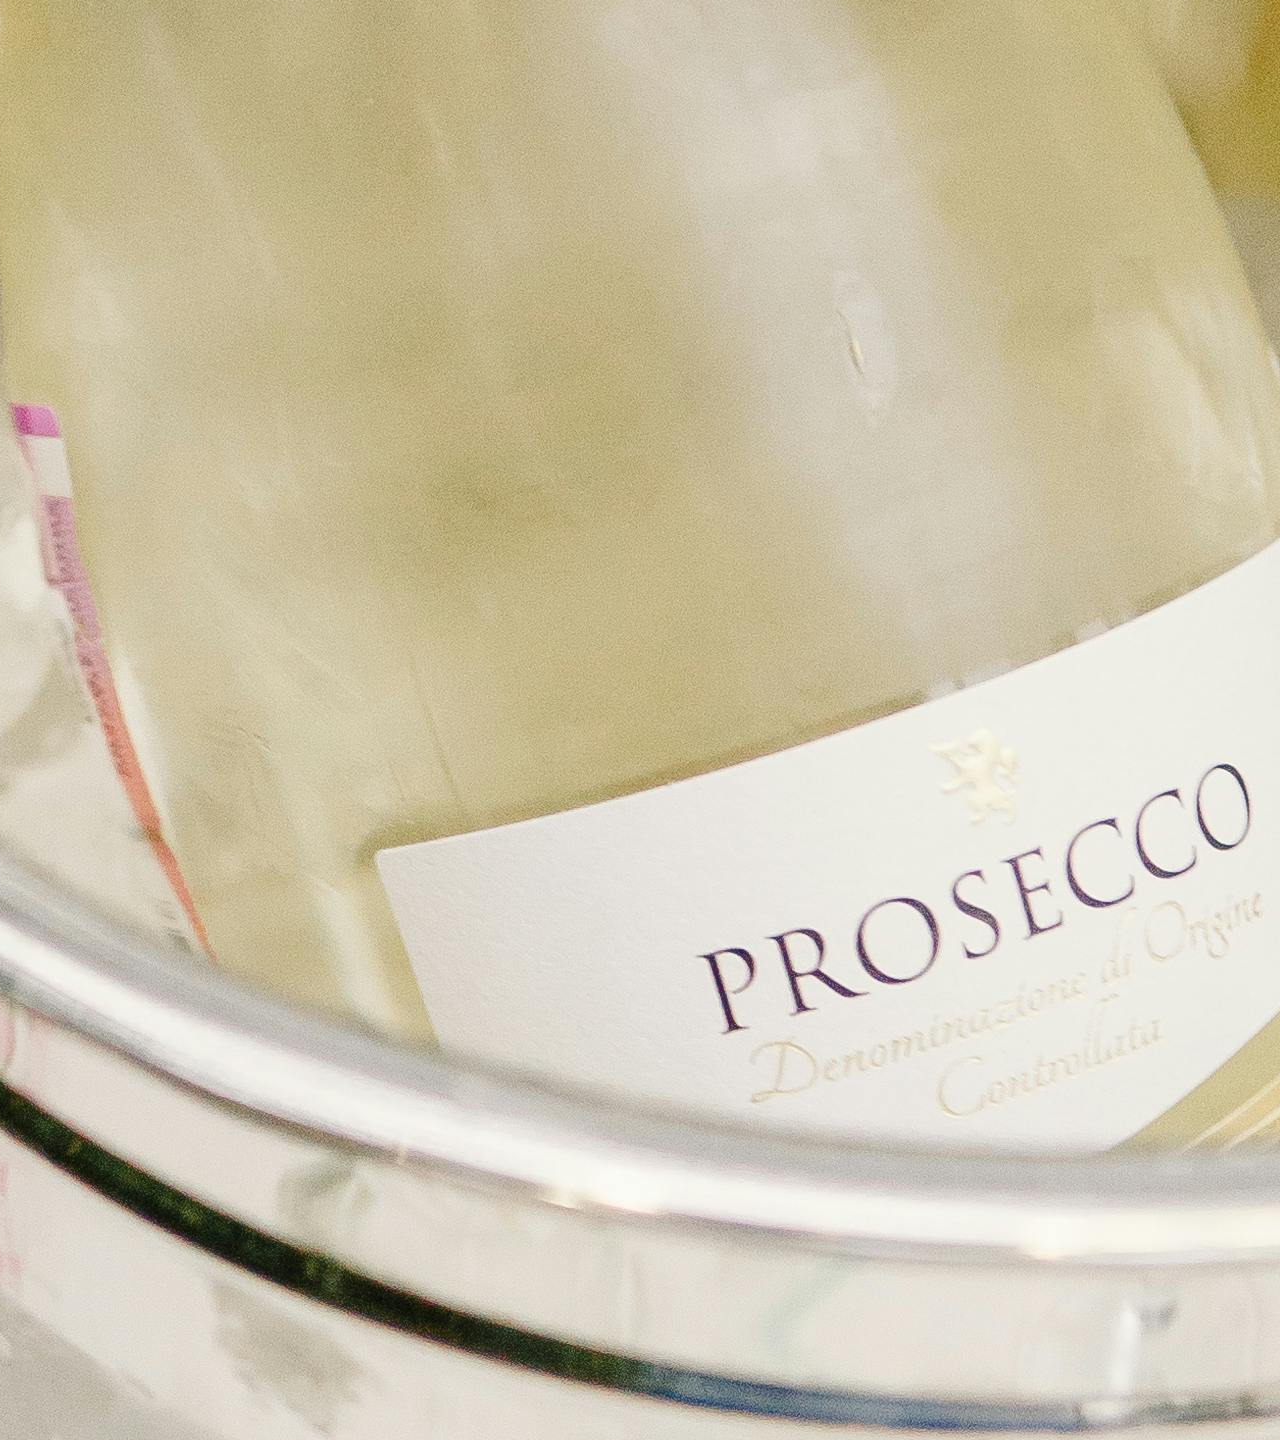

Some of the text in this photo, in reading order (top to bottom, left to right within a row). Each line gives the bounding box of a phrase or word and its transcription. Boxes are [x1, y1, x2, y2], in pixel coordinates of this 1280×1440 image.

[695, 763, 1252, 1035] PROSECCO
[749, 890, 1266, 1105] Denominazione di Origine
[937, 994, 1166, 1117] Controllata
